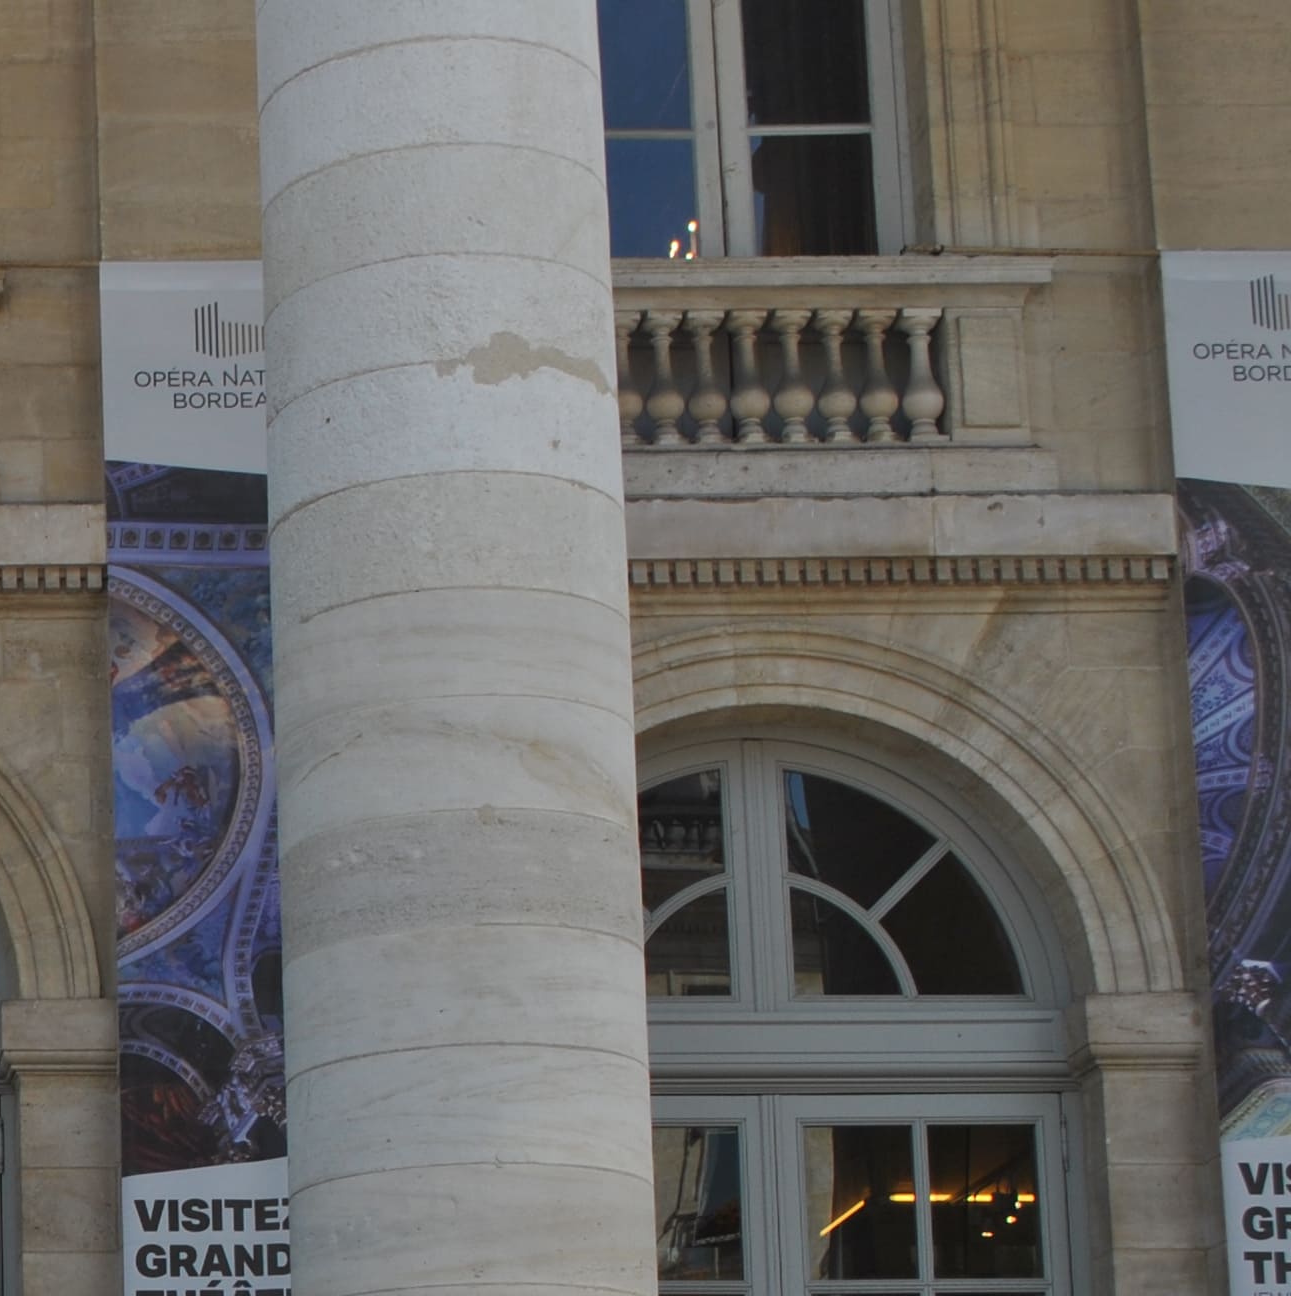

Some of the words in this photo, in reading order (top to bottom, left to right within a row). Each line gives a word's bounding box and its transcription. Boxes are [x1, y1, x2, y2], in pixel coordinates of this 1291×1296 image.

[1193, 340, 1272, 360] OPÉRA
[134, 366, 214, 388] OPÉRA
[1237, 1162, 1291, 1196] VI
[135, 1243, 292, 1278] GRAND
